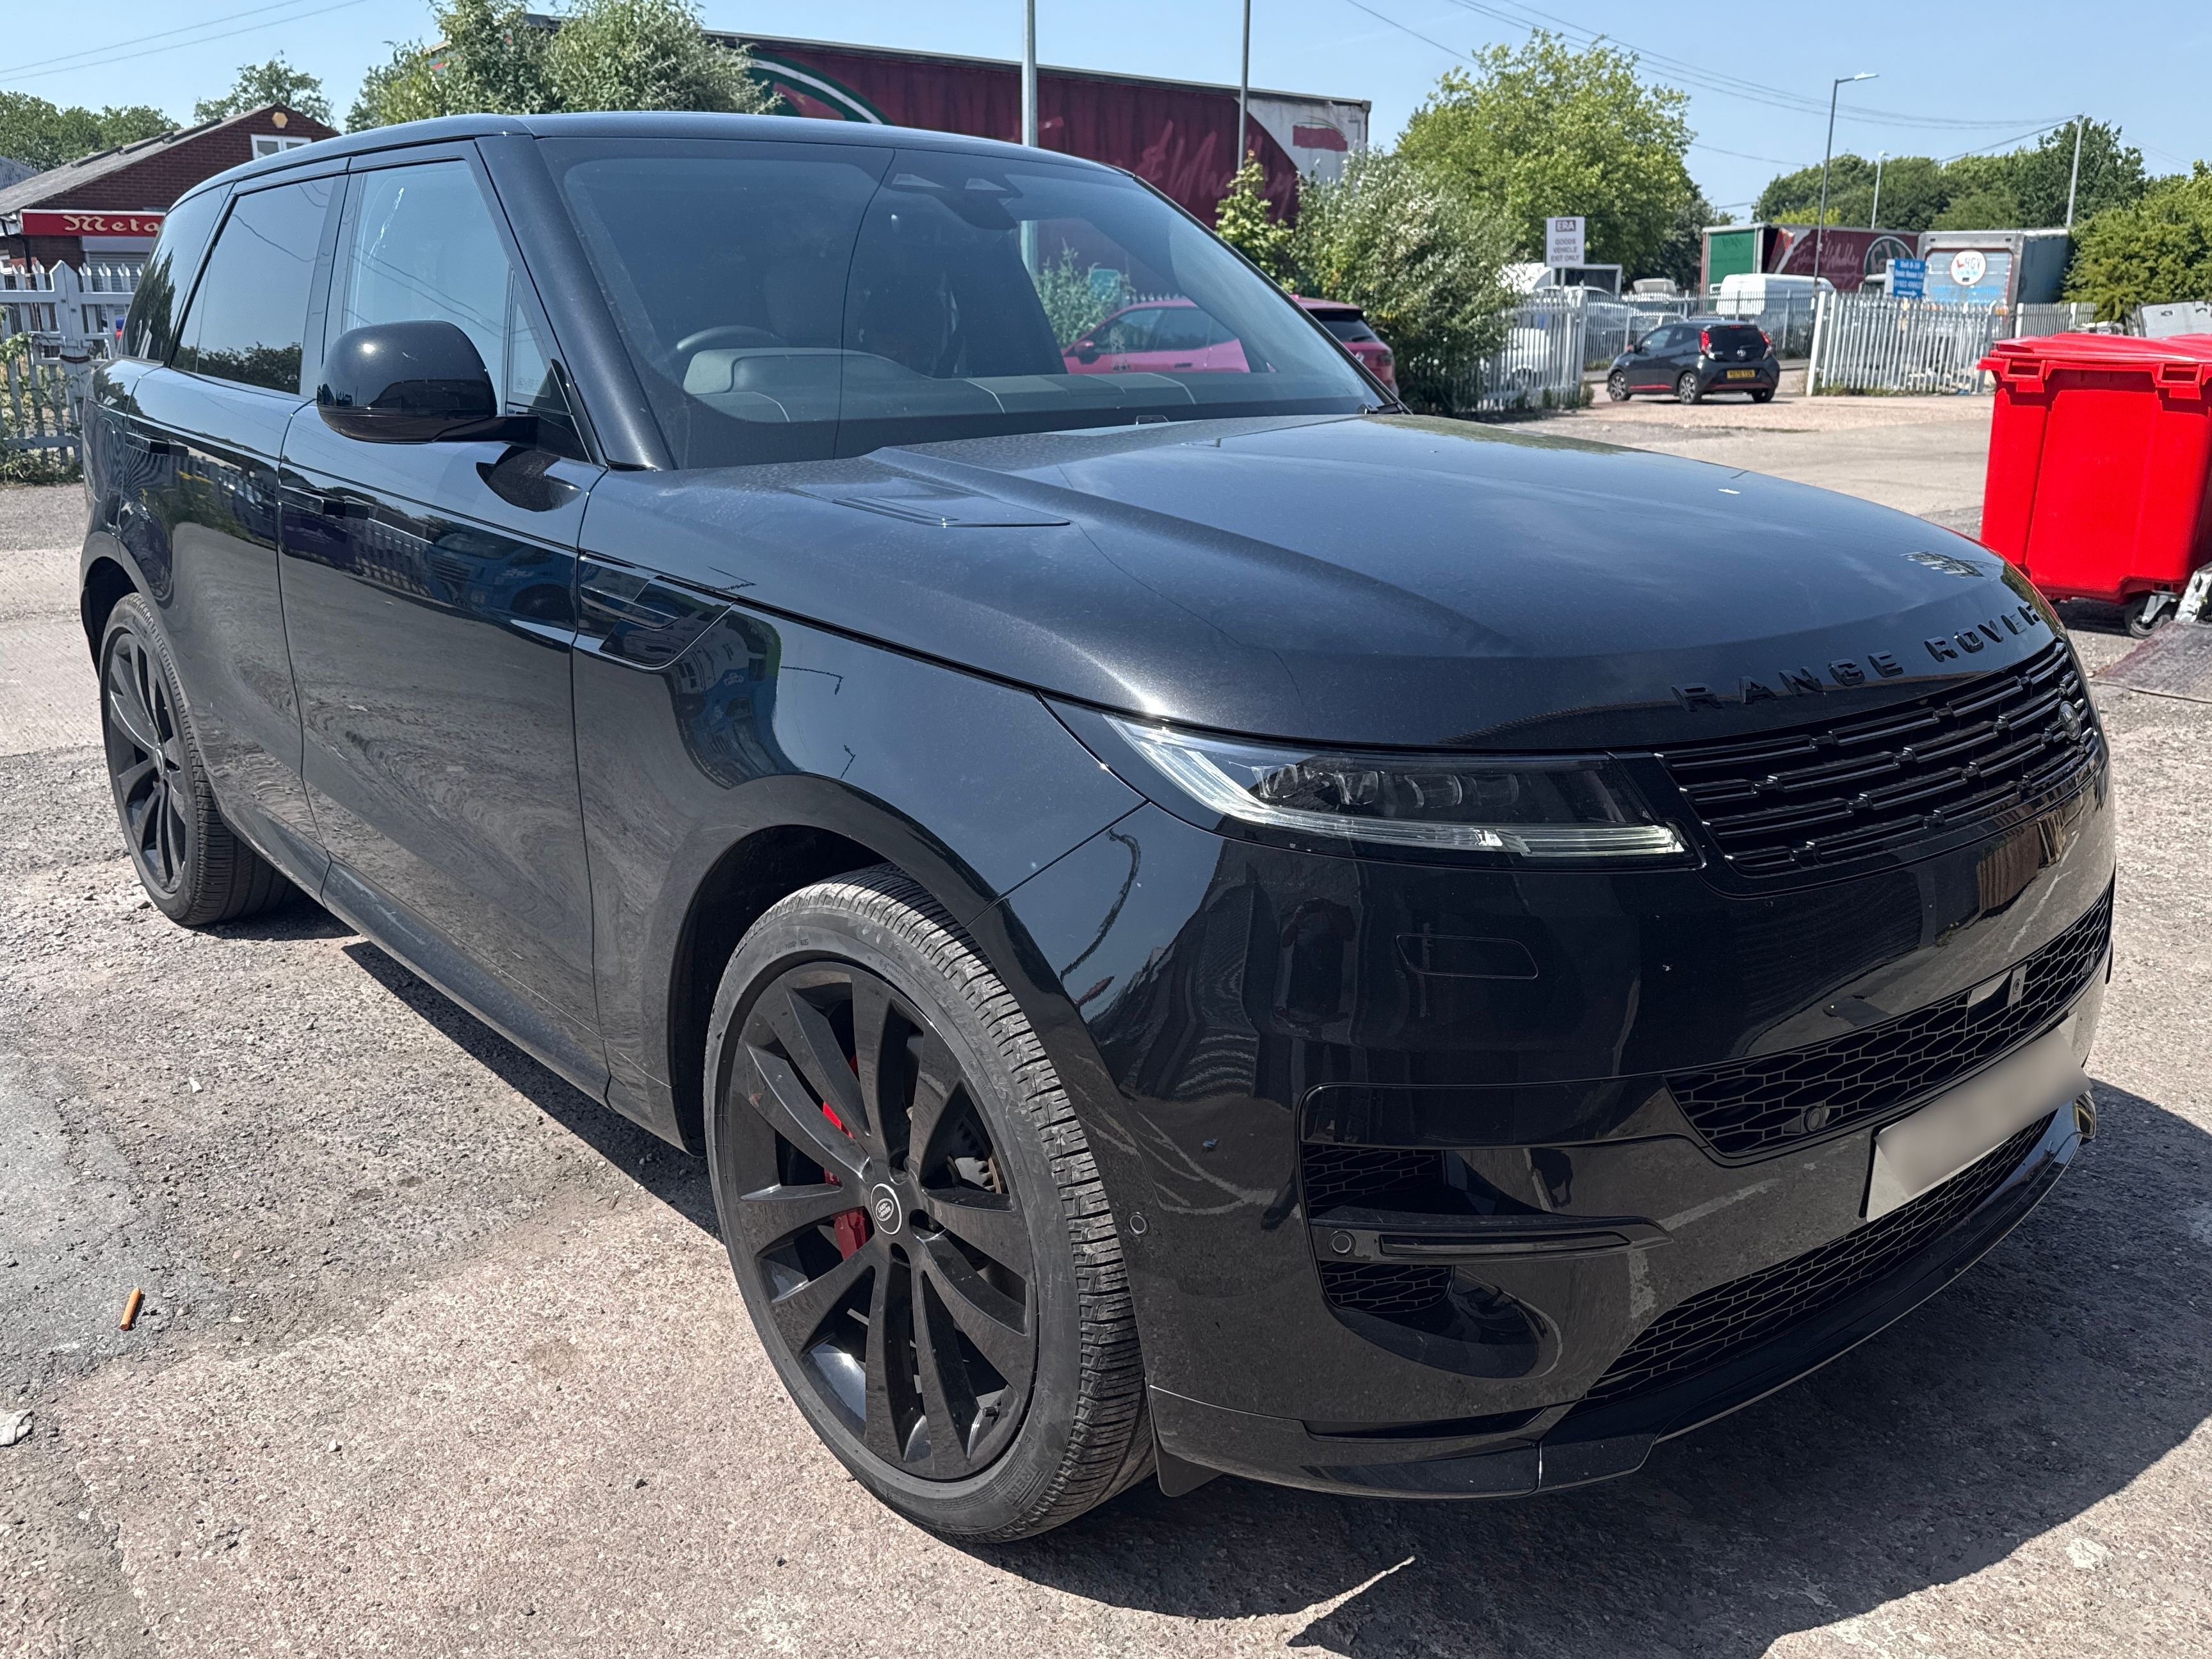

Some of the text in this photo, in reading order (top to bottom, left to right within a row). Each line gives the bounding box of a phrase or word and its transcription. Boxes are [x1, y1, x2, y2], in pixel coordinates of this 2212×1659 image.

[1556, 221, 1575, 231] ERA
[1670, 602, 2041, 712] RANGE ROVER
[878, 1202, 888, 1213] LAND
[880, 1206, 891, 1217] ROVER
